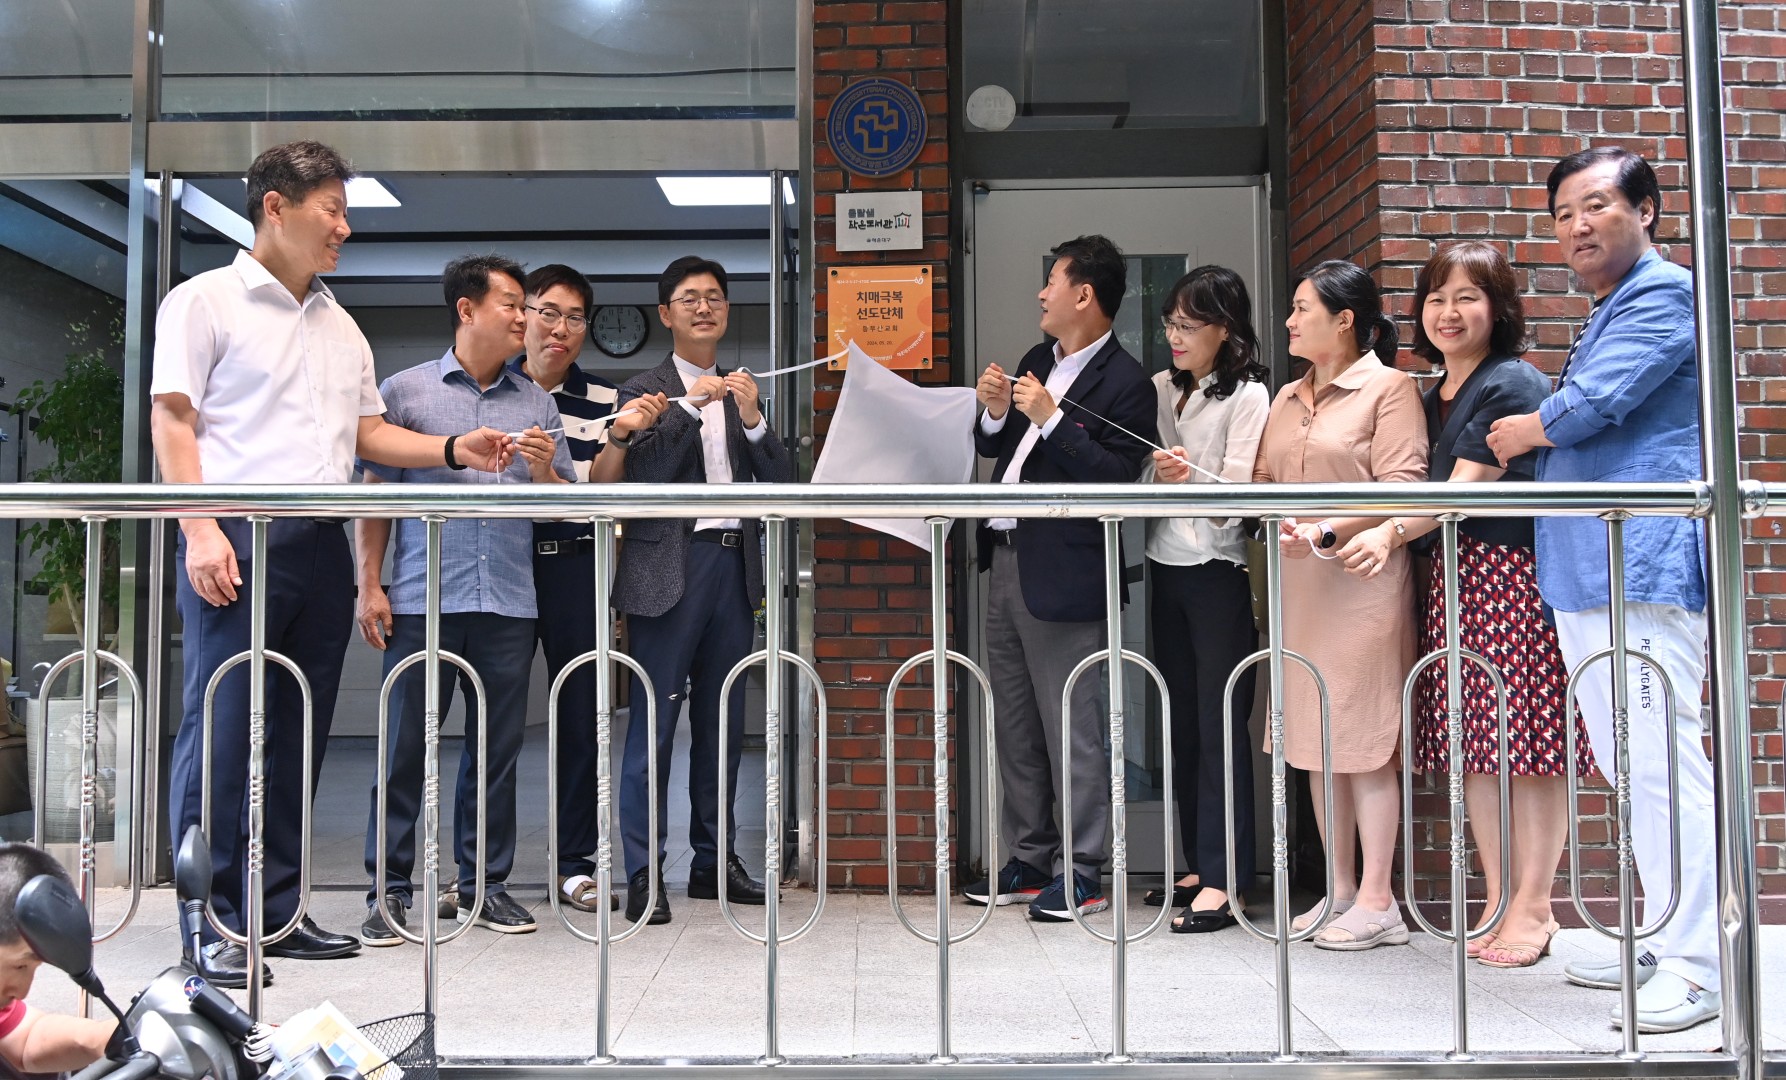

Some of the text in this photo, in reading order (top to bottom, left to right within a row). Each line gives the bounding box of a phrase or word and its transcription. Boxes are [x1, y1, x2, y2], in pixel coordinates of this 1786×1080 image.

[848, 218, 893, 230] 작은도서관
[856, 291, 903, 304] 치매극복
[856, 306, 903, 320] 선도단체
[1640, 638, 1650, 709] PELYGATES
